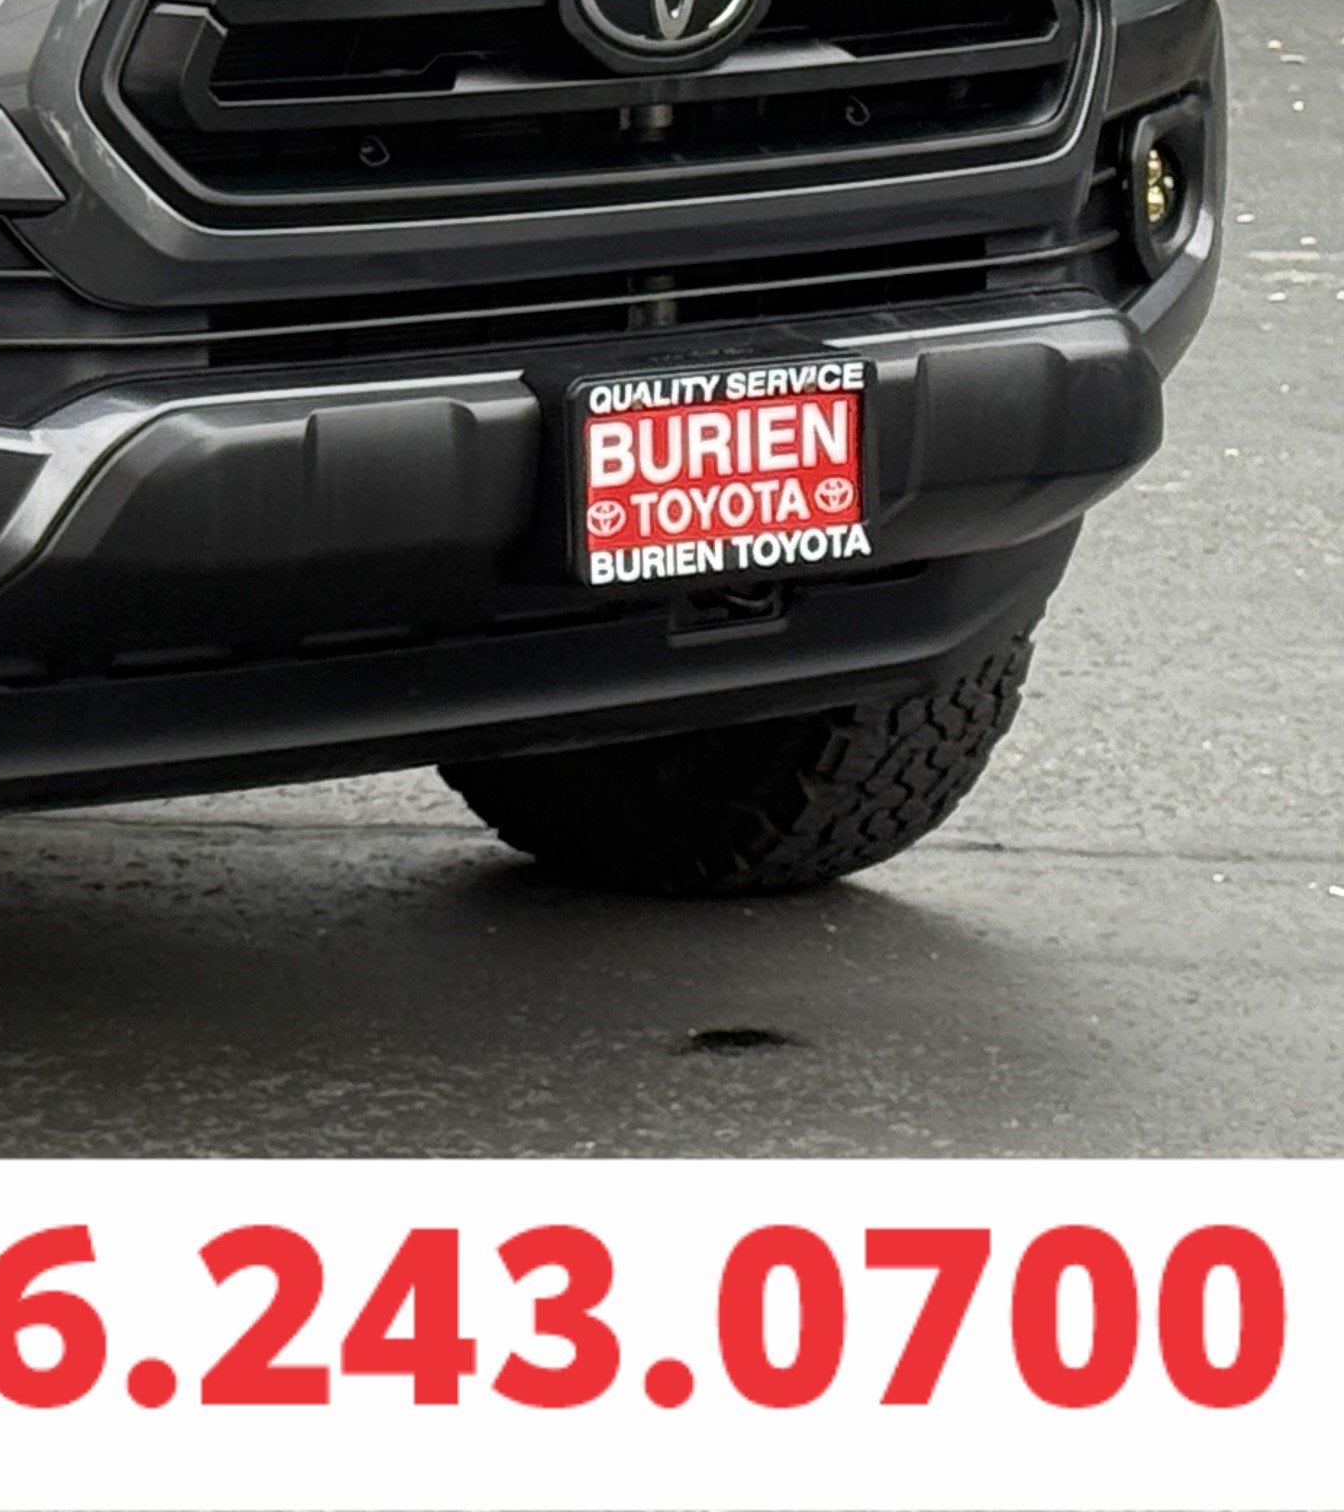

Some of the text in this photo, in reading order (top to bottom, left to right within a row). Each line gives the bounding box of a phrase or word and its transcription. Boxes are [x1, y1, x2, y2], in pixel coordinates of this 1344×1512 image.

[589, 361, 865, 414] QUALITY SERVICE
[589, 399, 849, 488] BURIEN
[629, 477, 811, 538] TOYOTA
[590, 522, 872, 586] BURIEN TOYOTA
